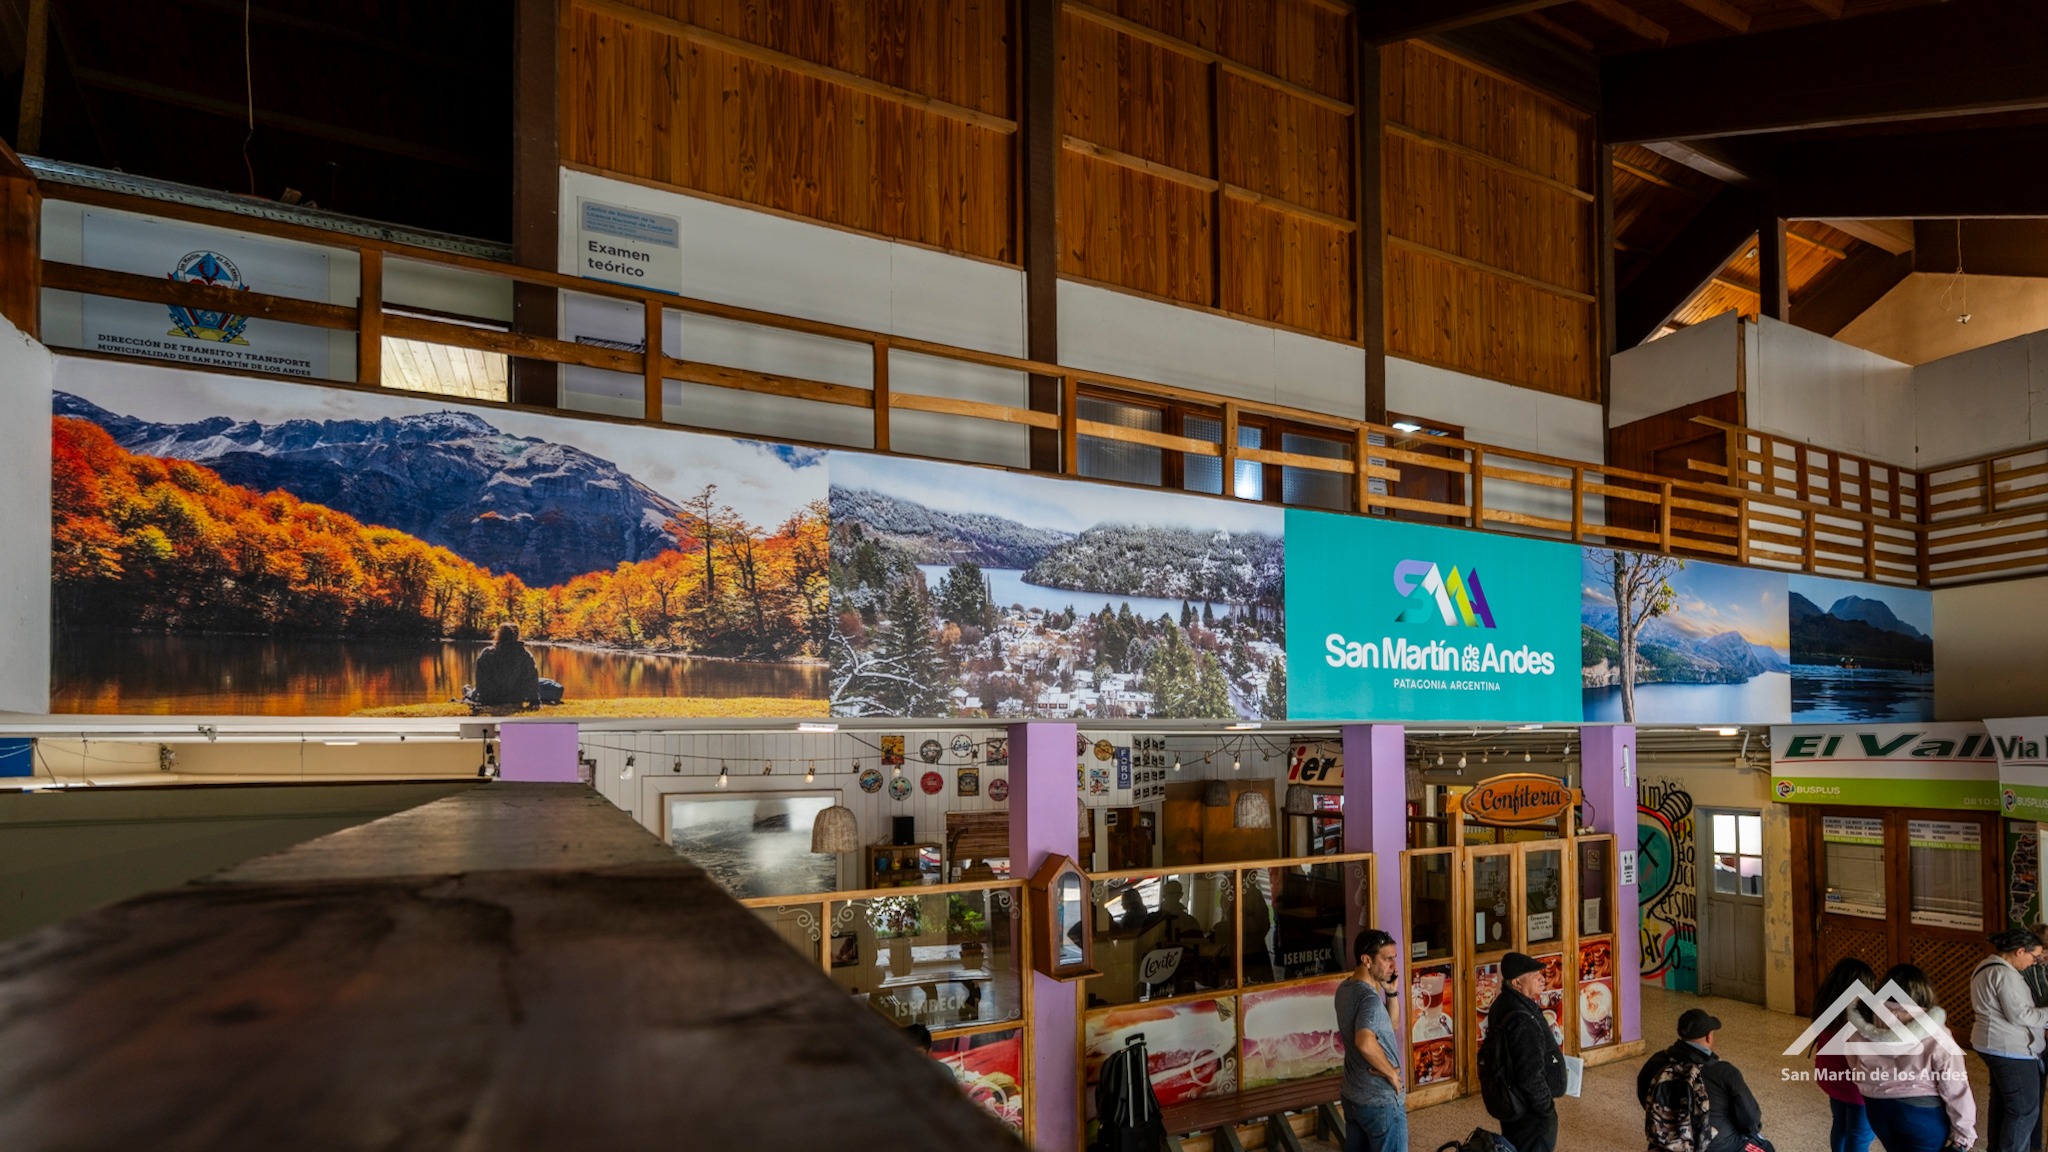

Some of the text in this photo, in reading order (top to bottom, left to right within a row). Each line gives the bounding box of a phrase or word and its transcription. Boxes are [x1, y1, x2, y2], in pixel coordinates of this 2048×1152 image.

[588, 240, 650, 263] Examen
[588, 257, 645, 278] teórico
[97, 333, 161, 348] DIRECCIÓN
[164, 343, 178, 351] DE
[180, 345, 235, 358] TRANSITO
[244, 353, 312, 368] TRANSPORTE
[97, 344, 176, 359] MUNICIPALIDAD
[192, 355, 210, 364] SAN
[212, 356, 249, 368] MARTÍN
[251, 362, 263, 370] DE
[264, 364, 281, 372] LOS
[282, 367, 312, 376] ANDES
[1325, 632, 1556, 676] San Martín de los Andes
[1393, 678, 1501, 692] PATAGONIA ARGENTINA
[1783, 733, 1845, 759] El
[1995, 735, 2040, 760] Via
[1120, 749, 1128, 781] FORD
[1480, 783, 1562, 816] Confitería
[1796, 785, 1841, 796] BUSPLUS
[1144, 950, 1179, 978] Levité
[1283, 947, 1332, 966] ISENBECK
[894, 994, 967, 1018] ISENBECK
